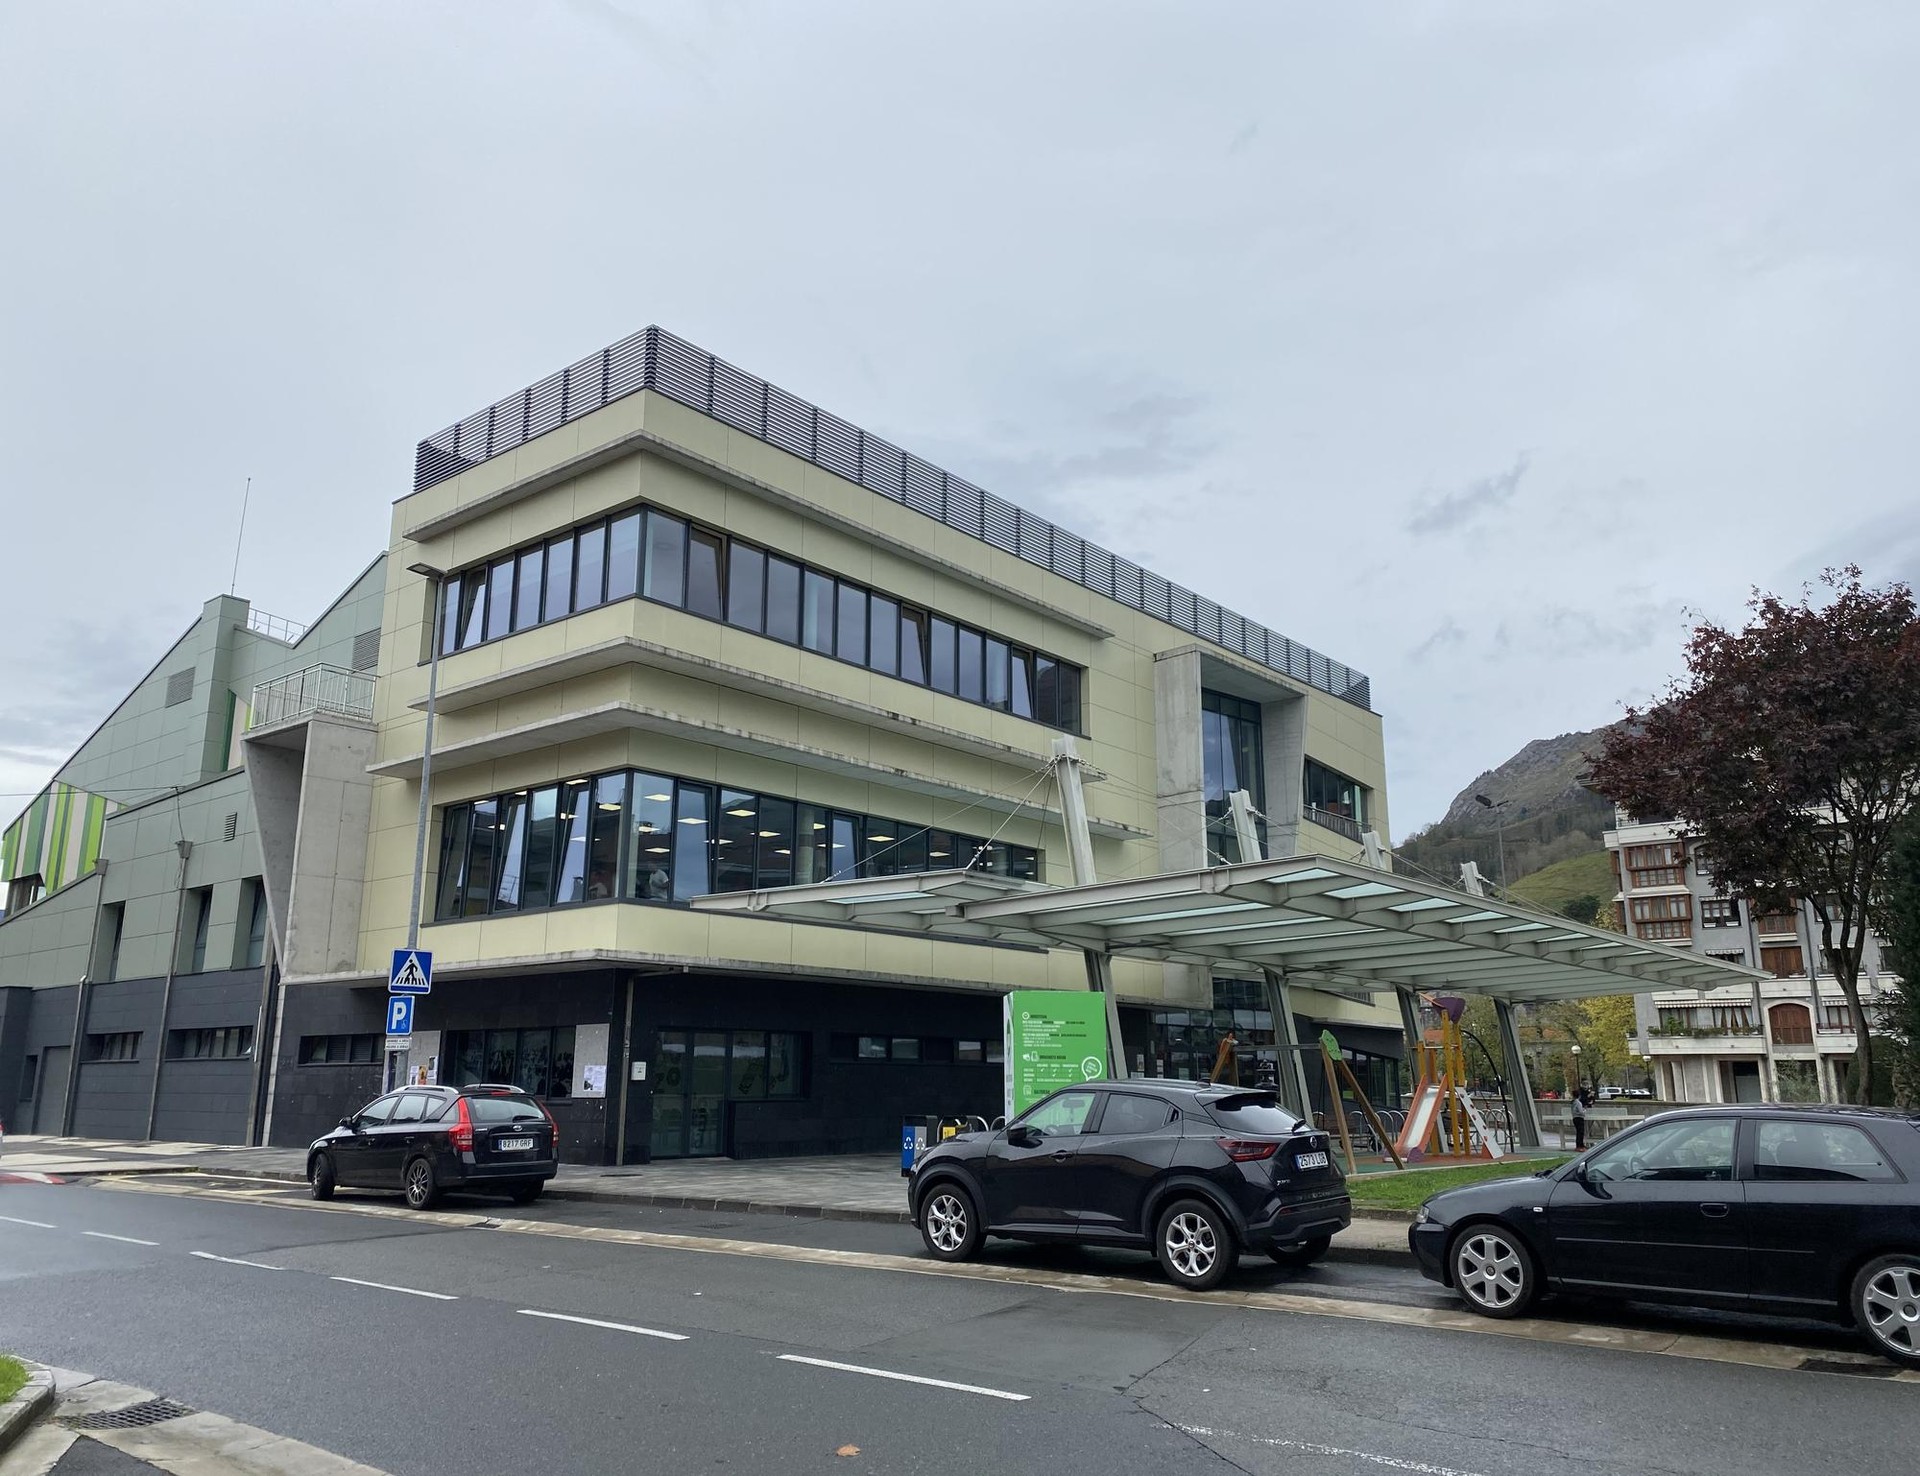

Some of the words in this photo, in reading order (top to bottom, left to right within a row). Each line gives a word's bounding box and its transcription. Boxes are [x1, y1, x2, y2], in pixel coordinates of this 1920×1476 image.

[392, 1002, 407, 1029] P
[502, 1140, 519, 1148] 8217
[1299, 1154, 1316, 1167] 2573
